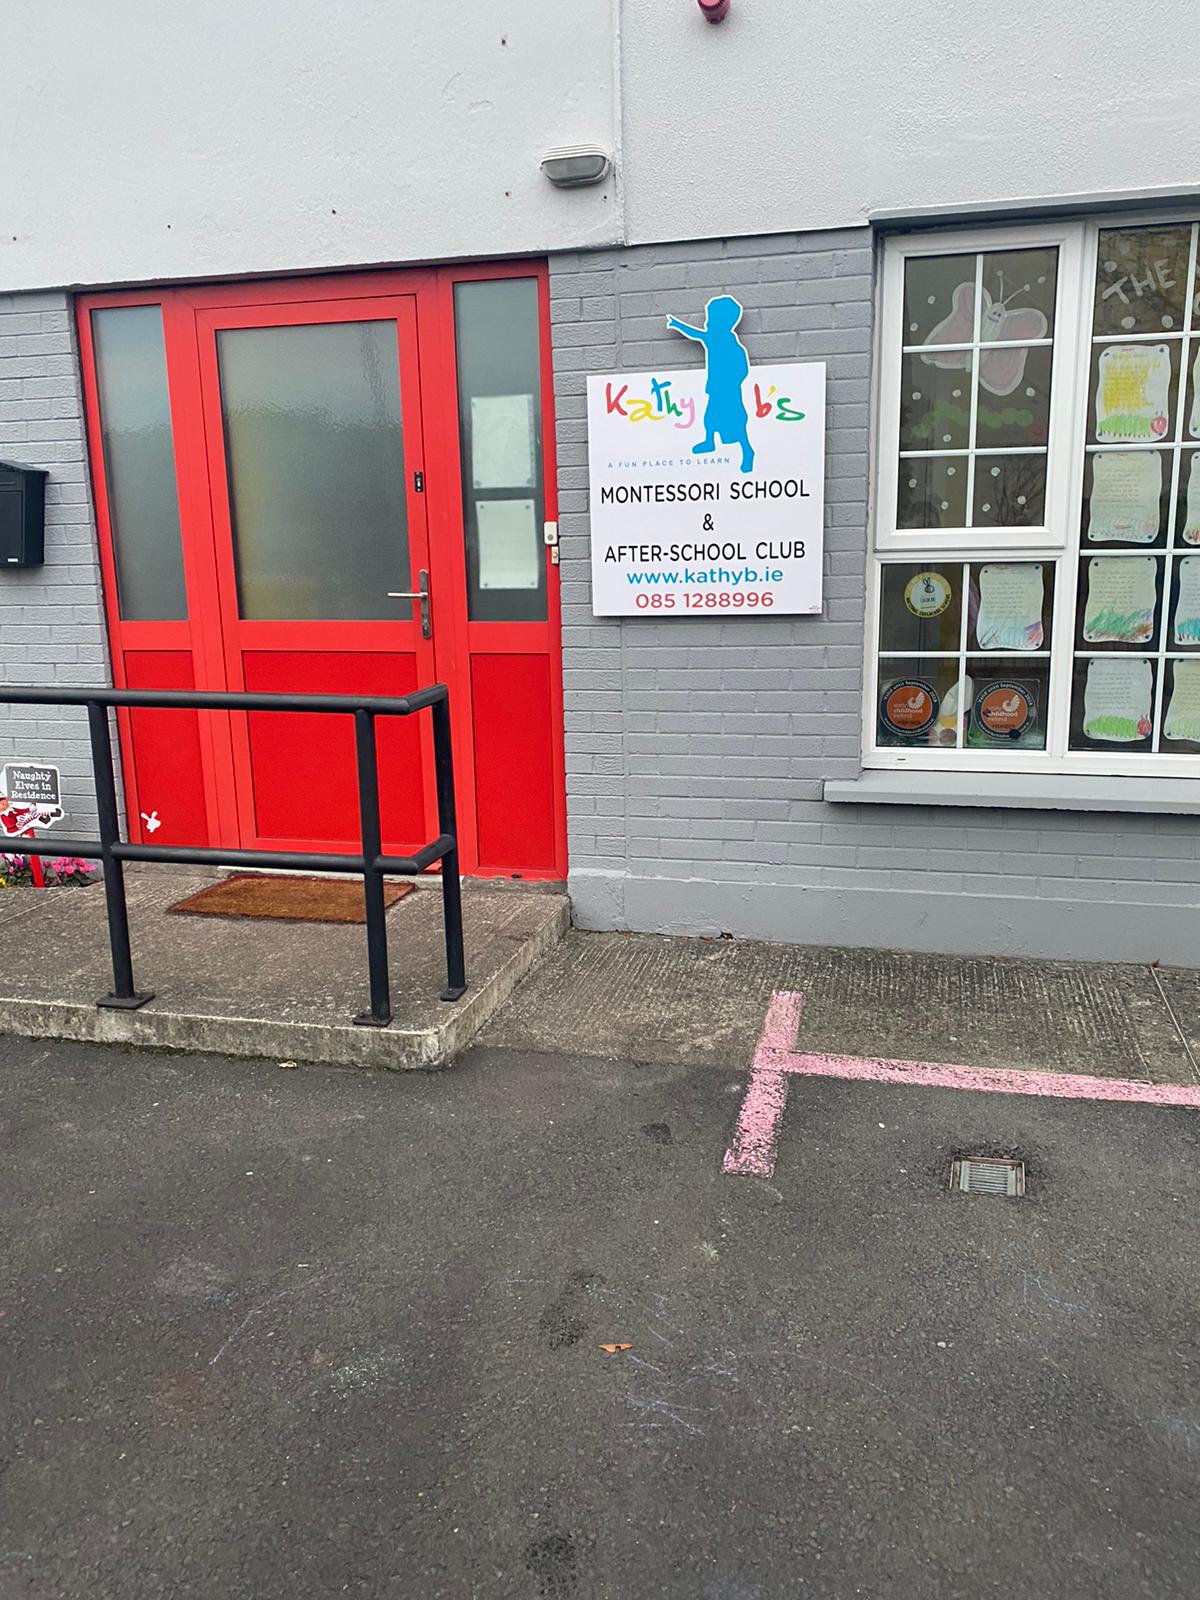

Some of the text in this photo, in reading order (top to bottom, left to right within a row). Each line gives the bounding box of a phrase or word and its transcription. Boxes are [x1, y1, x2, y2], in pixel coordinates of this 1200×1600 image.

[1102, 259, 1177, 305] THE
[605, 378, 806, 429] Kathy b's
[618, 461, 637, 469] FUN
[642, 459, 674, 468] PLACE
[679, 458, 692, 466] TO
[697, 456, 731, 465] LEARN
[601, 479, 810, 505] MONTESSORI SCHOOL
[702, 513, 715, 532] &
[604, 541, 806, 563] AFTER-SCHOOL CLUB
[626, 566, 784, 586] www.kathyb.ie
[635, 591, 775, 609] 085 1288996
[12, 771, 51, 781] Naughty
[15, 780, 51, 790] Elves in
[11, 791, 56, 800] Residence
